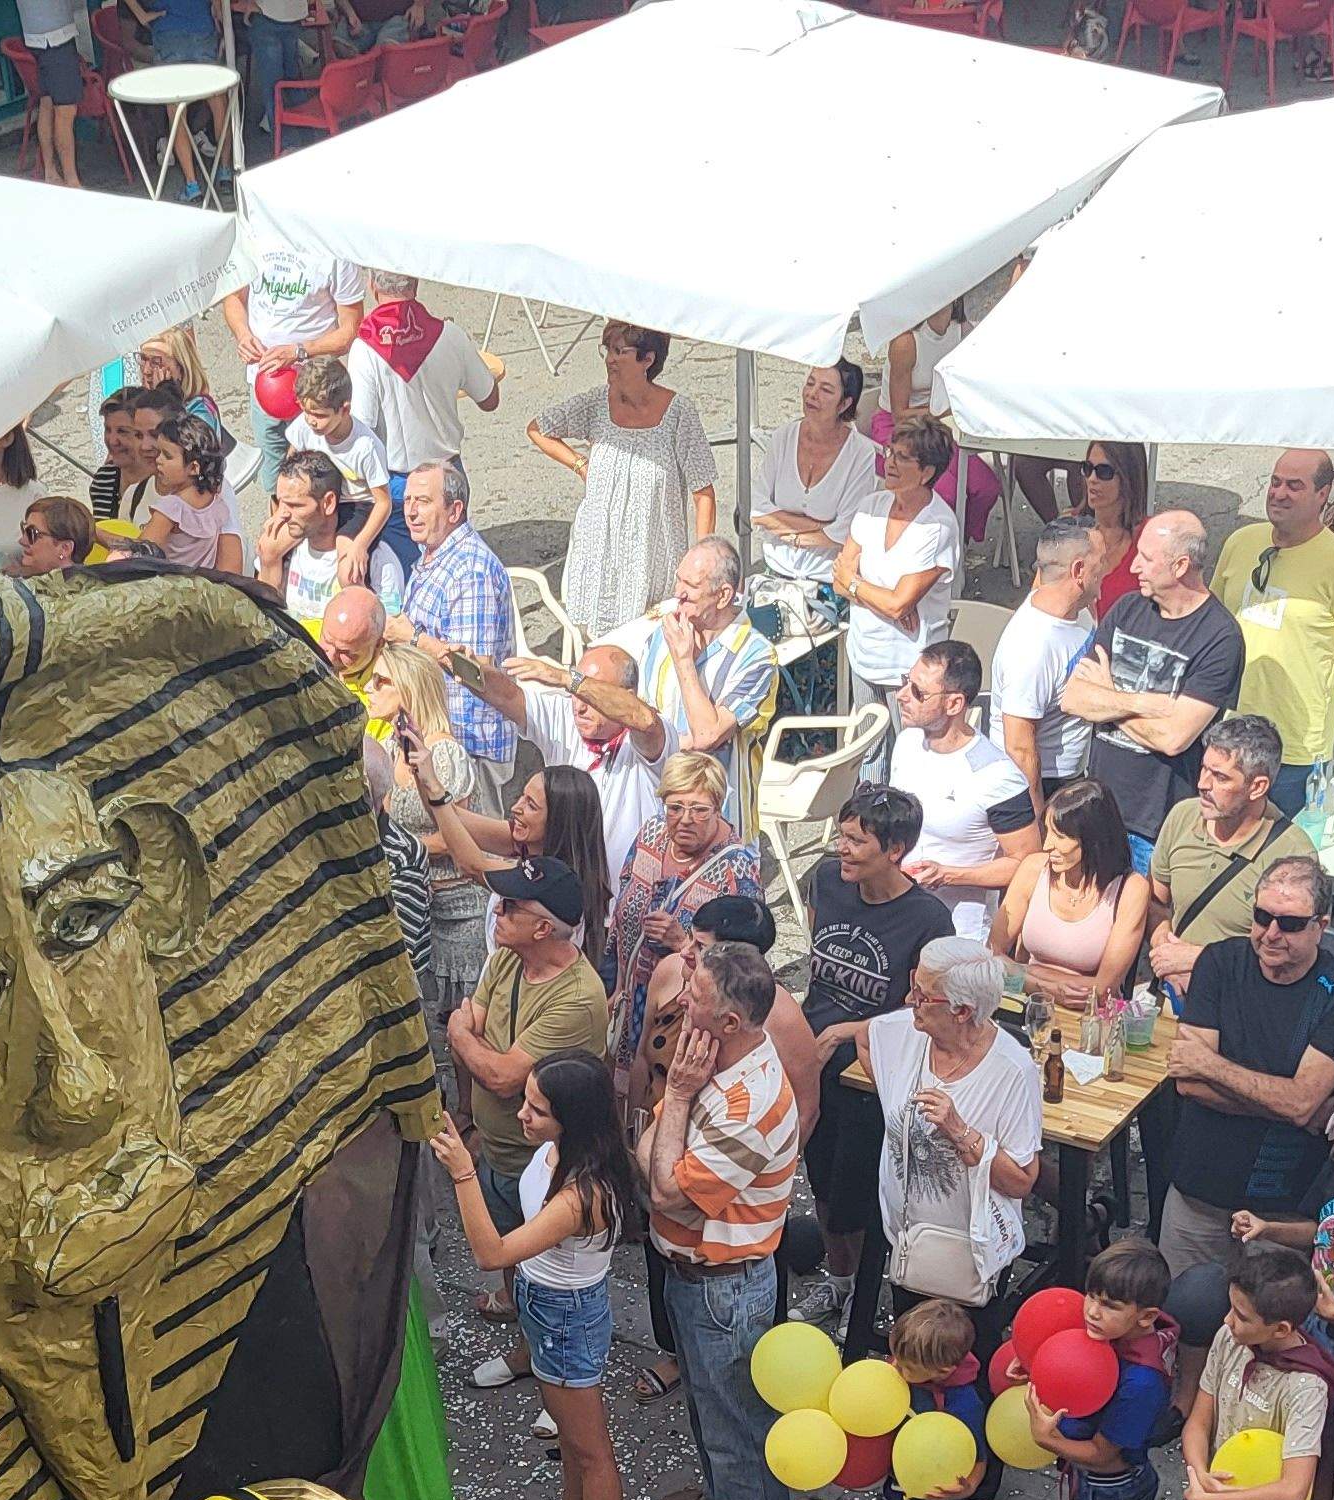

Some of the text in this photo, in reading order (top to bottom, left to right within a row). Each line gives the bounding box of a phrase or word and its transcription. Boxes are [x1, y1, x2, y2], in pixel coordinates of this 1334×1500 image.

[111, 260, 237, 335] CERVECEROS INDEPENDIENTES
[826, 942, 853, 960] KEEP
[853, 953, 870, 967] ON
[810, 956, 889, 1003] OCKING
